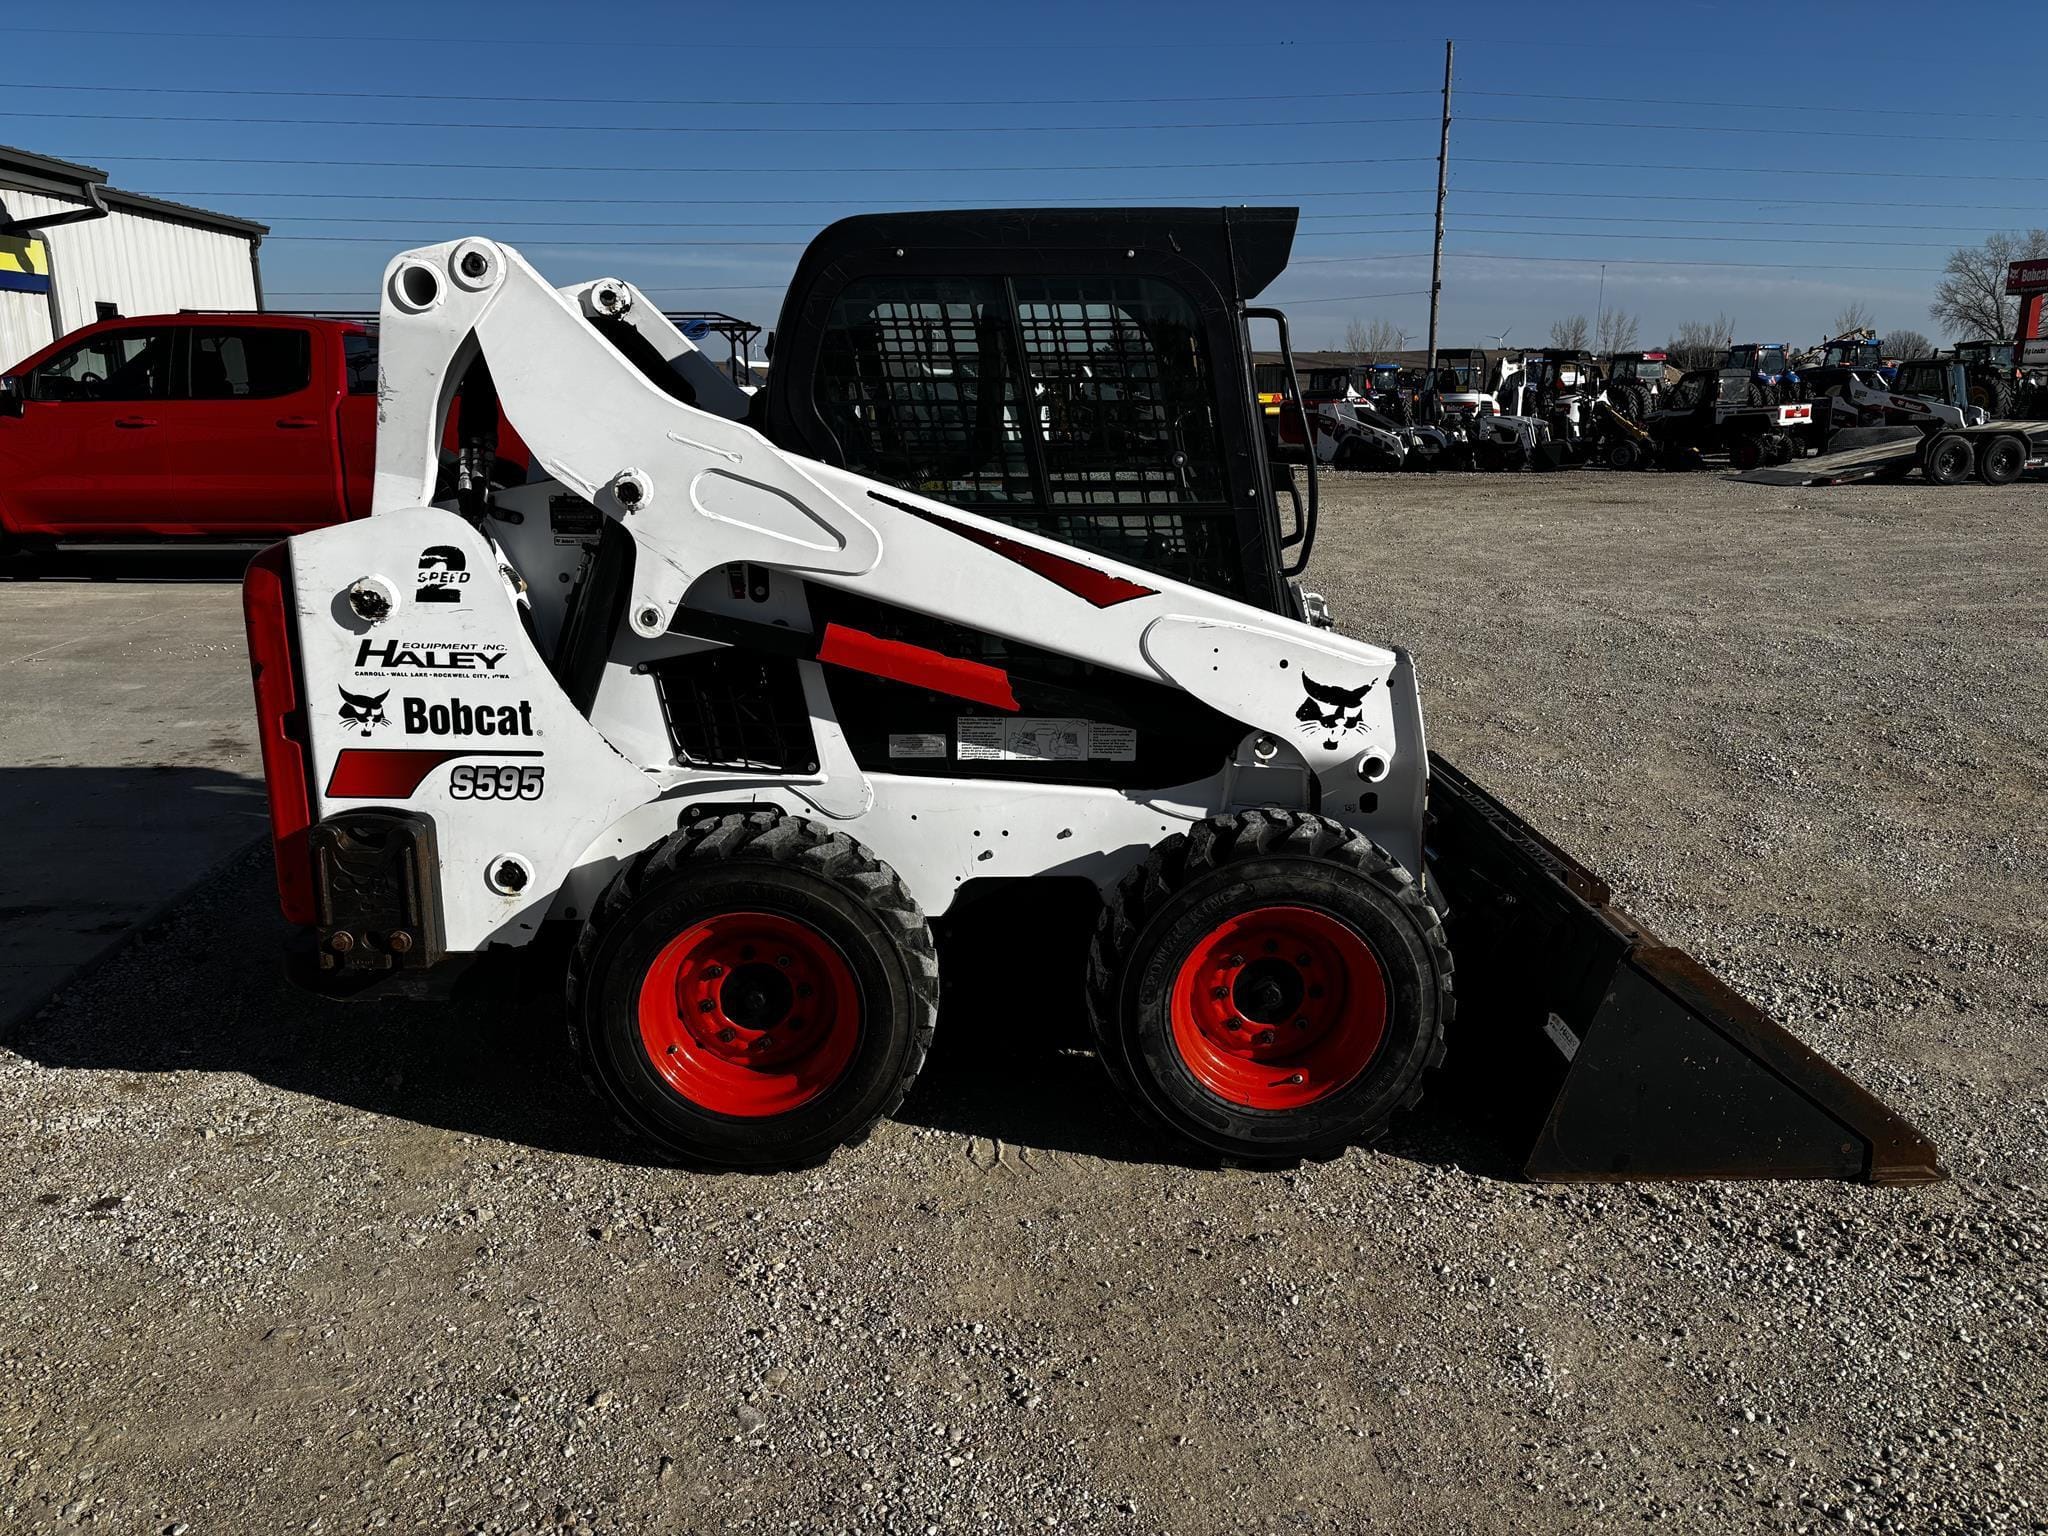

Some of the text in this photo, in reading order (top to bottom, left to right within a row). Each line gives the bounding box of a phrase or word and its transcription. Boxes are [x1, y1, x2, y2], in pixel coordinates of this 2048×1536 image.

[415, 545, 466, 603] 2
[417, 571, 471, 583] SPEED
[354, 639, 507, 669] HALEY
[402, 642, 479, 650] EQUIPMENT
[403, 697, 533, 736] Bobcat
[449, 765, 545, 800] S595
